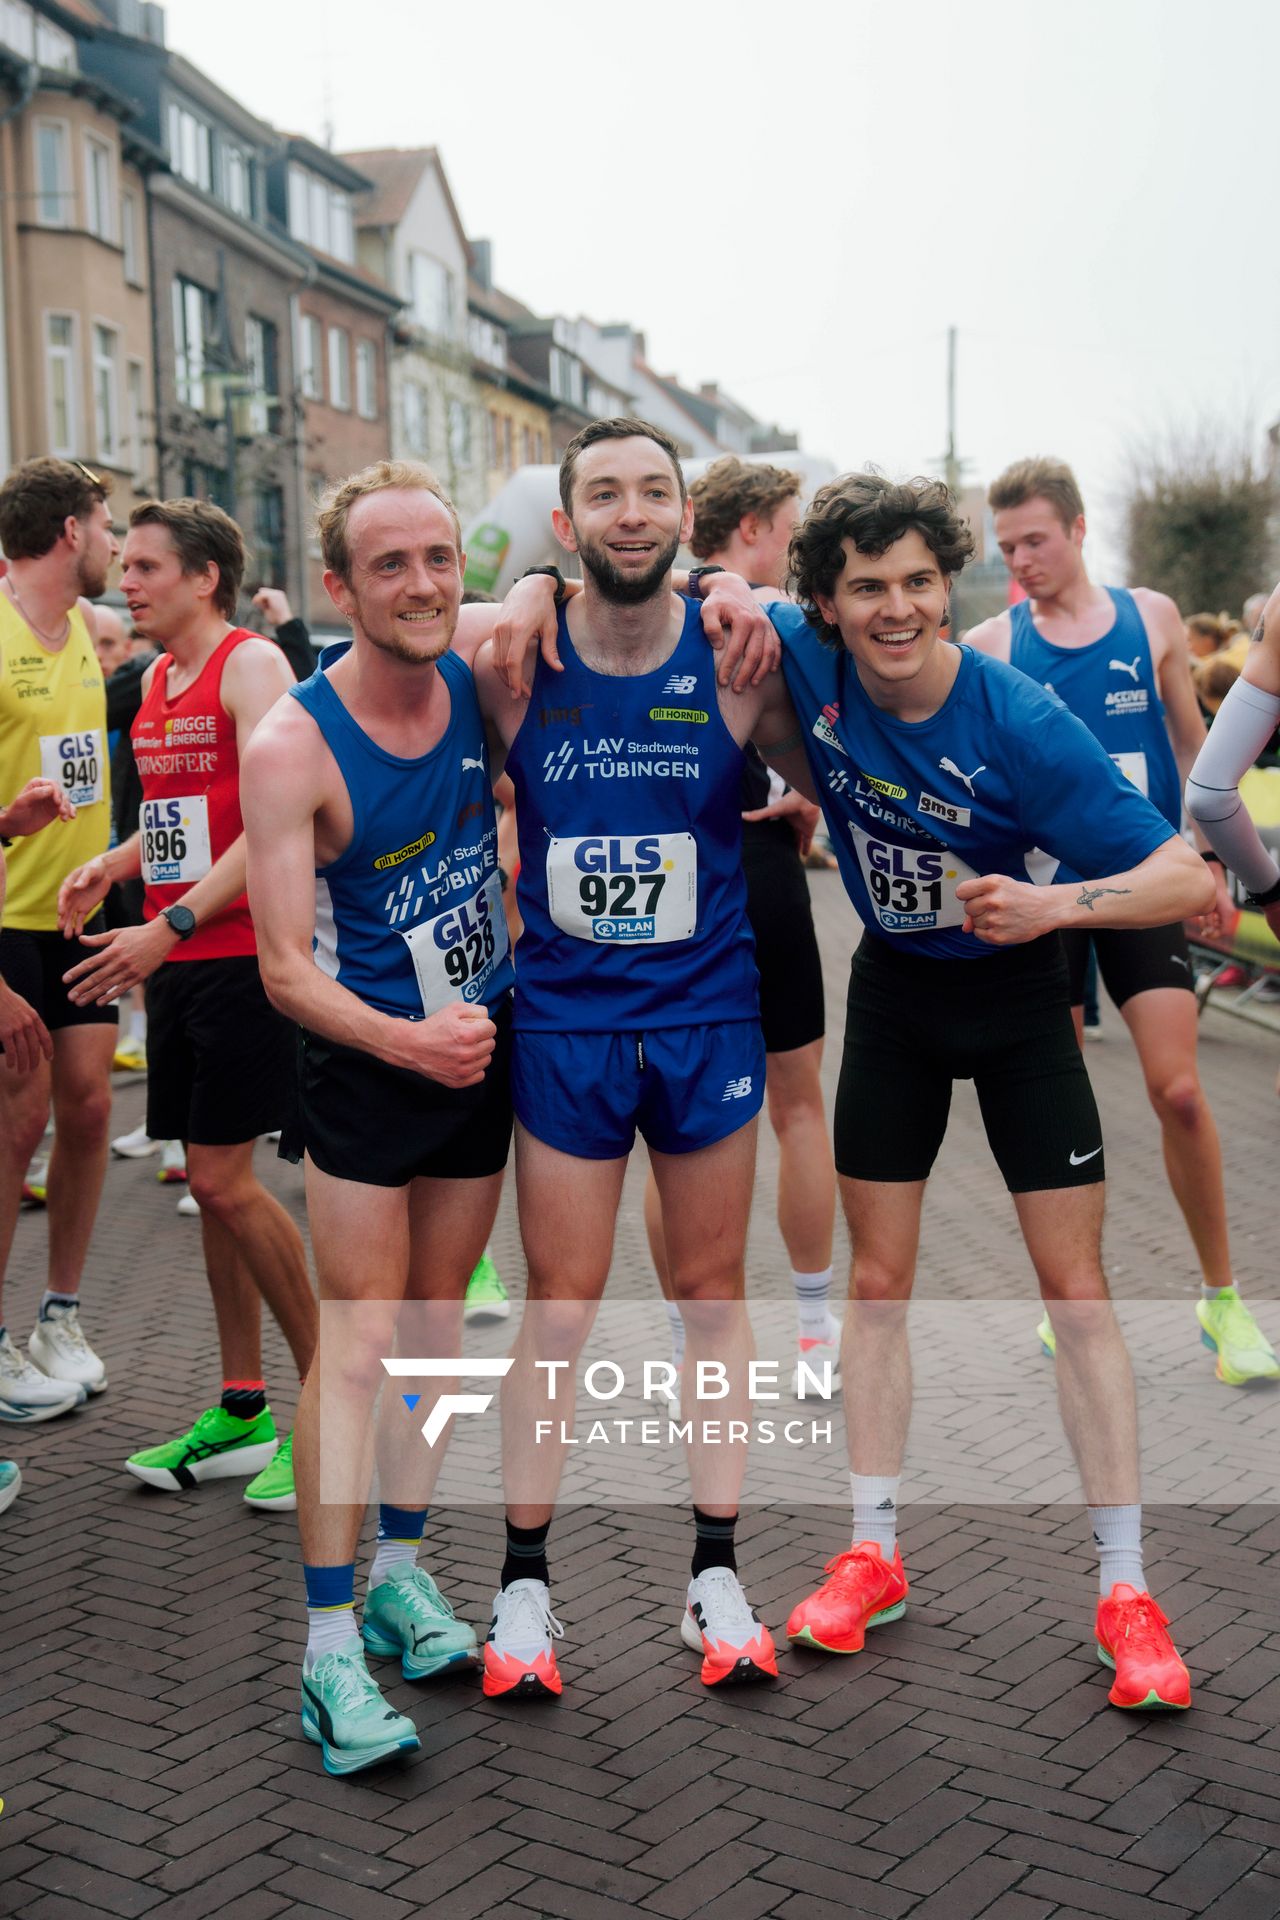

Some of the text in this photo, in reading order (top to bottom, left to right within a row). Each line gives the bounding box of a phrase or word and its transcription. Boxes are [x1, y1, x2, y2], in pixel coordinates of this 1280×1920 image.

[173, 715, 217, 733] BIGGE
[666, 710, 694, 720] HORN
[59, 734, 94, 759] GLS
[173, 732, 217, 745] ENERGIE
[583, 738, 699, 755] LAV Stadtwerke
[63, 757, 97, 788] 940
[584, 757, 700, 779] TÜBINGEN
[855, 780, 881, 801] LA
[865, 775, 890, 793] ORN
[144, 801, 181, 829] GLS
[919, 797, 958, 822] gmg
[394, 843, 421, 863] HORN
[574, 838, 662, 873] GLS
[867, 840, 943, 880] GLS
[579, 874, 666, 916] 927
[870, 869, 942, 912] 931
[433, 889, 489, 950] GLS
[618, 921, 653, 932] PLAN
[900, 915, 935, 924] PLAN
[444, 918, 495, 987] 928
